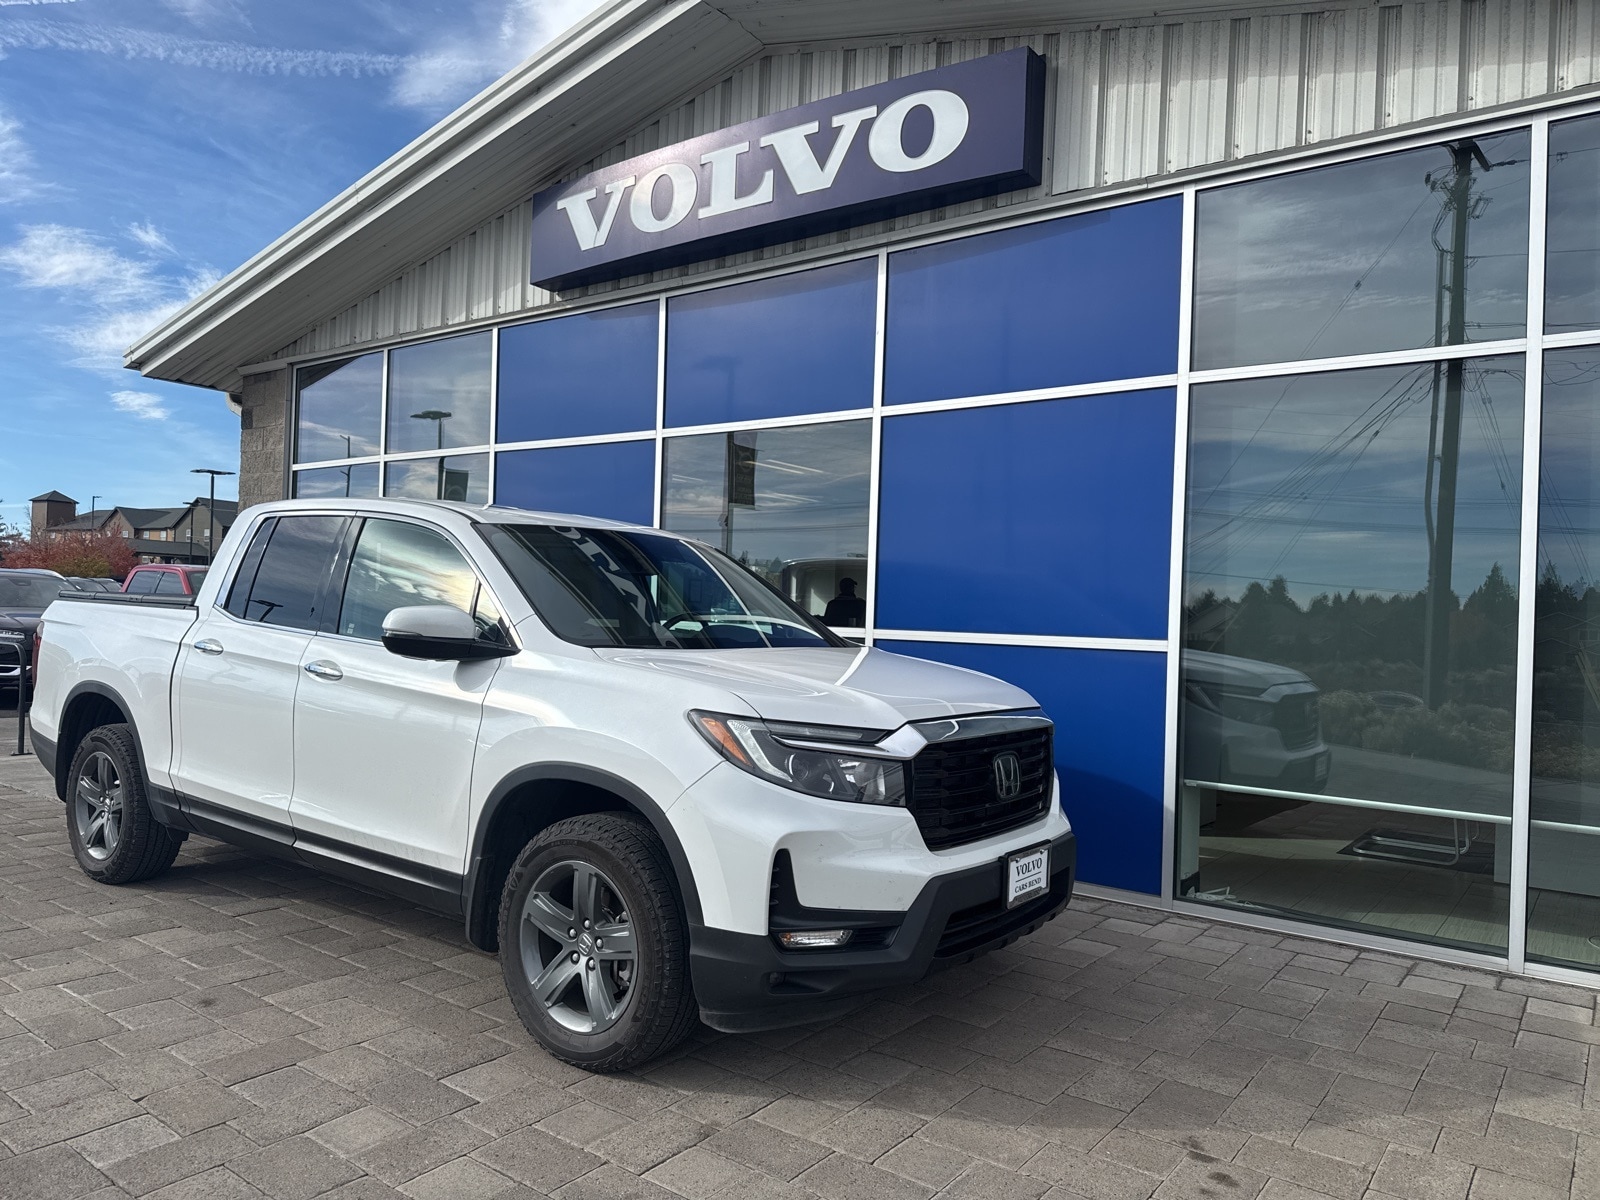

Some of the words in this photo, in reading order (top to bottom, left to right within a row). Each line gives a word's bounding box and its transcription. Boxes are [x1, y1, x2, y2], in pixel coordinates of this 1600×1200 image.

[556, 89, 969, 251] VOLVO
[1016, 858, 1042, 877] VOLVO
[1014, 882, 1028, 893] CARS
[1028, 877, 1042, 890] BEND
